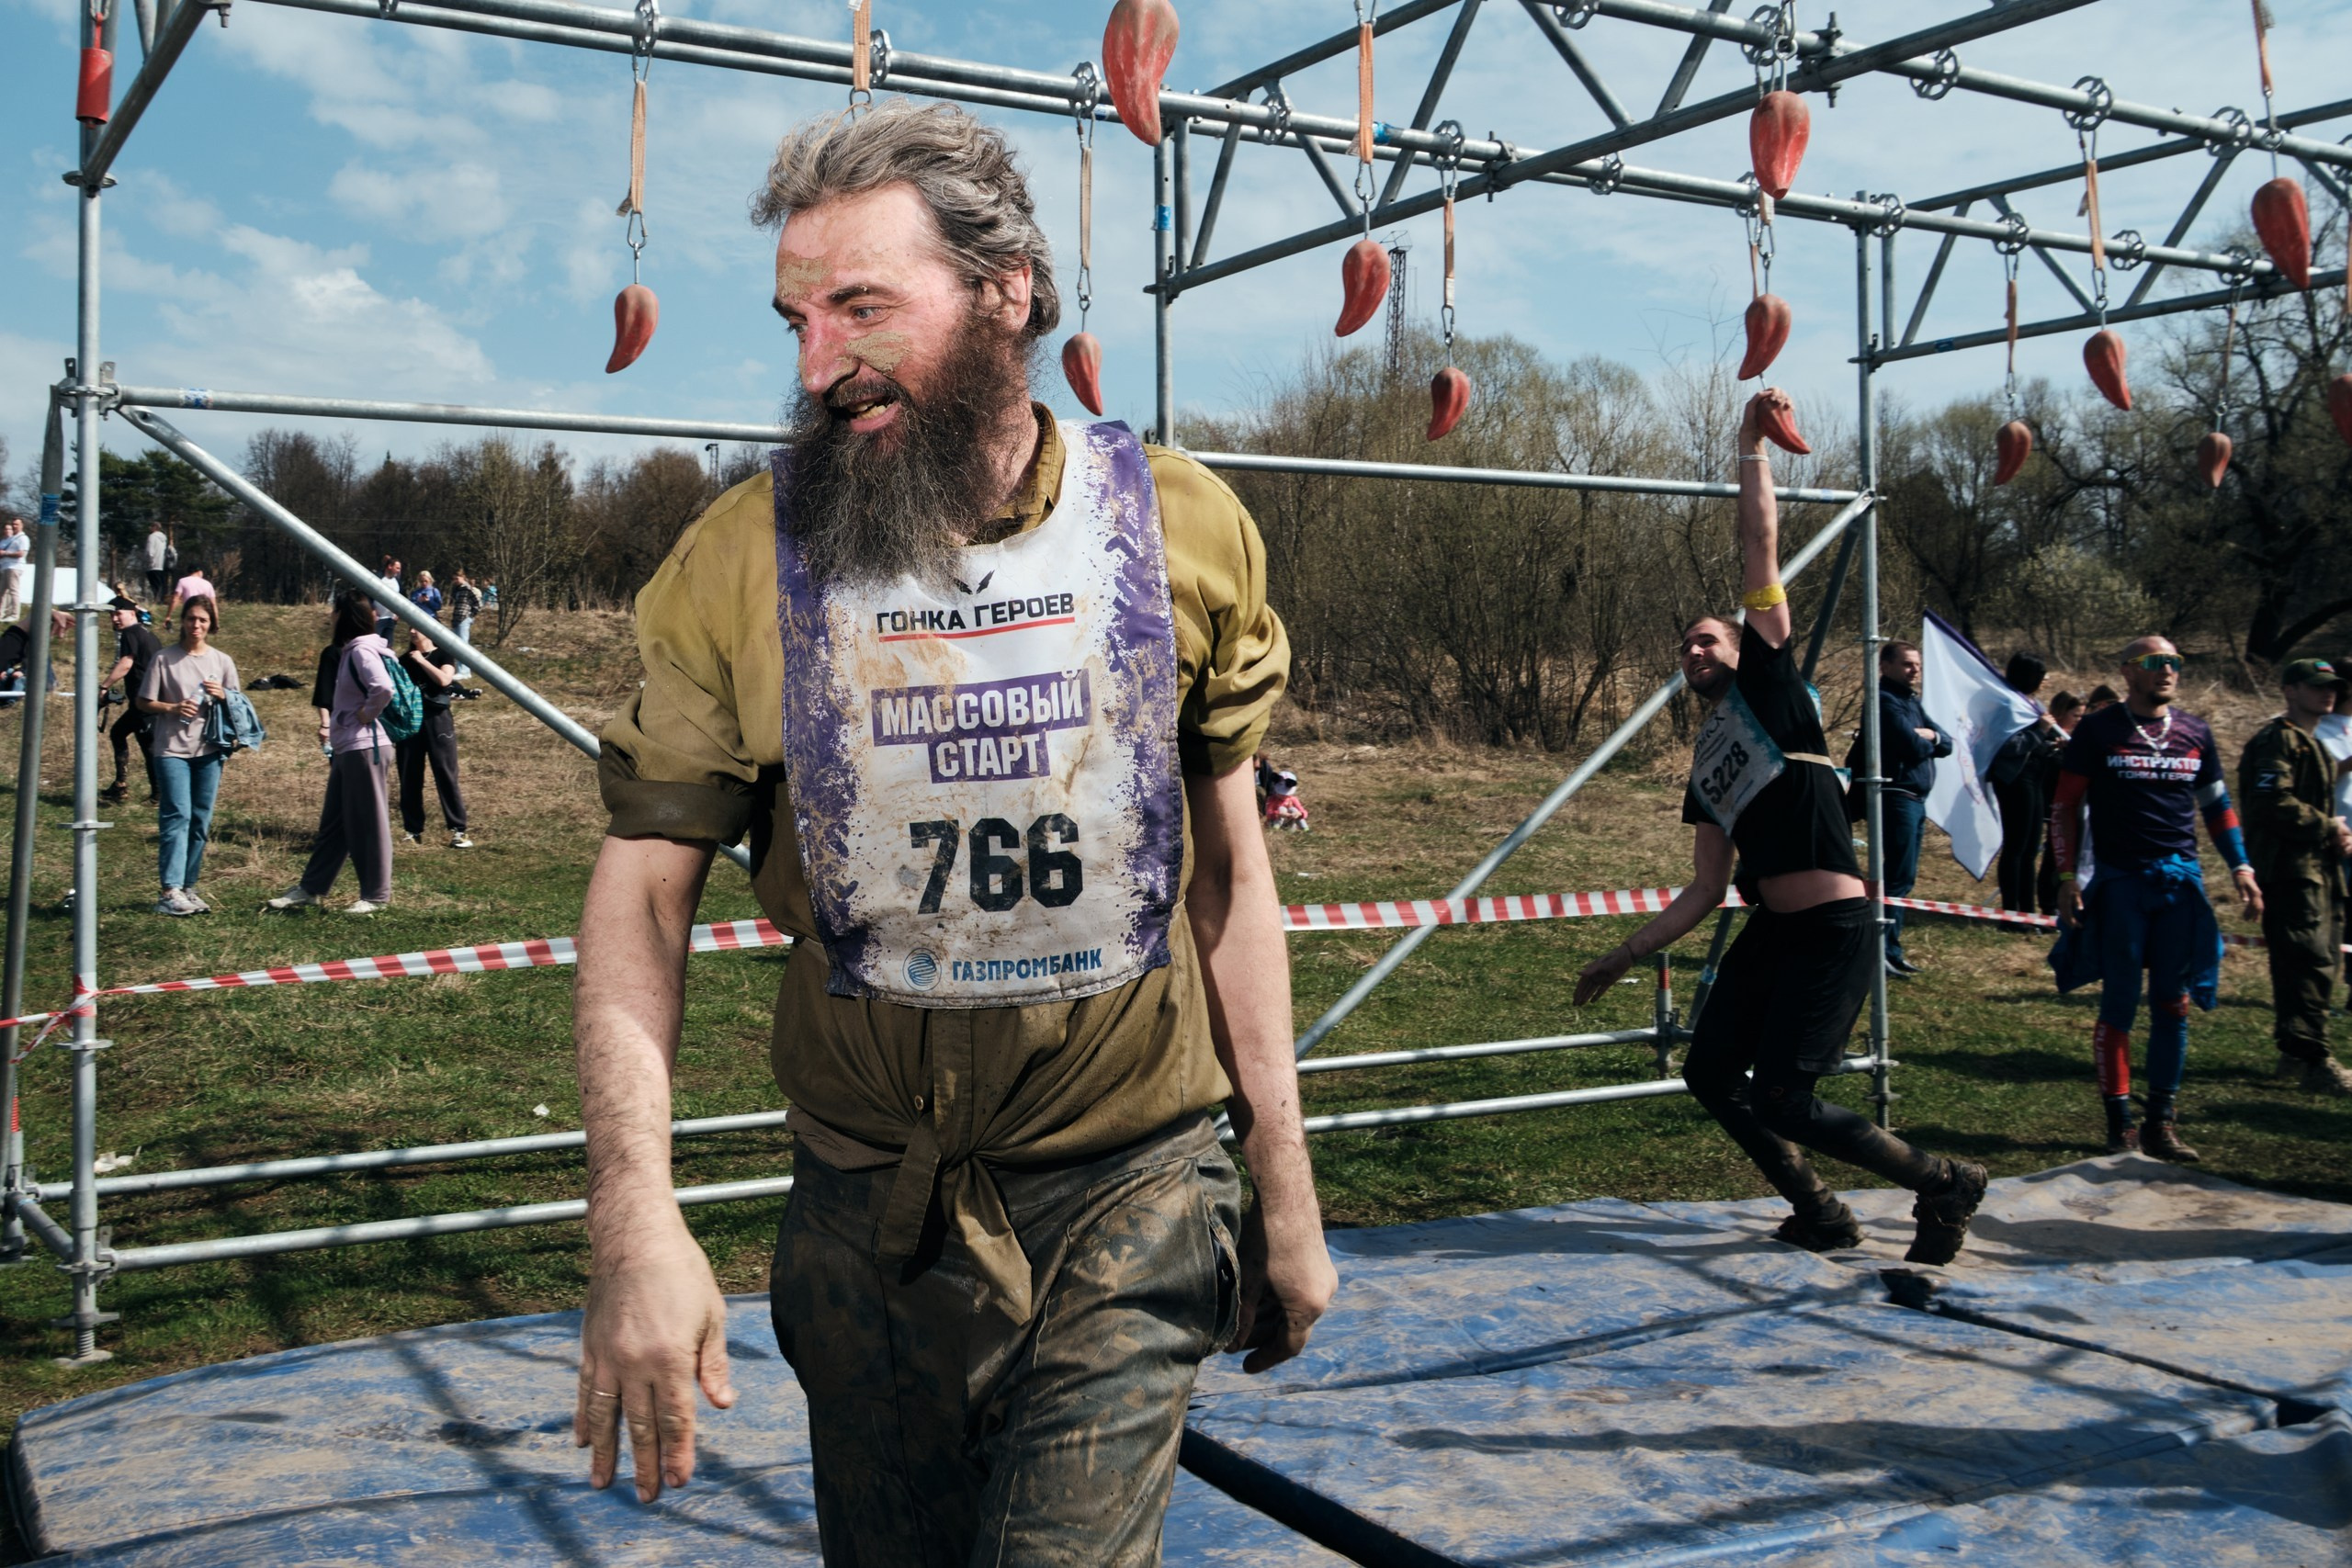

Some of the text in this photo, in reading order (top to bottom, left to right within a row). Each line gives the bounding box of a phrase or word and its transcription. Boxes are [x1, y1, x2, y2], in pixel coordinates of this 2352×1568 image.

[876, 592, 1075, 634] ГОНКА ГЕРОЕВ
[881, 670, 1084, 736] МАССОВЫЙ
[935, 734, 1040, 778] СТАРТ
[1701, 740, 1749, 805] 5228
[2107, 755, 2202, 772] ИНСТРУКТО
[2117, 771, 2197, 782] ГОНКА ГЕРОЕ
[2257, 773, 2277, 787] Z
[910, 813, 1085, 914] 766
[952, 948, 1102, 982] ГАЗПРОМБАНК
